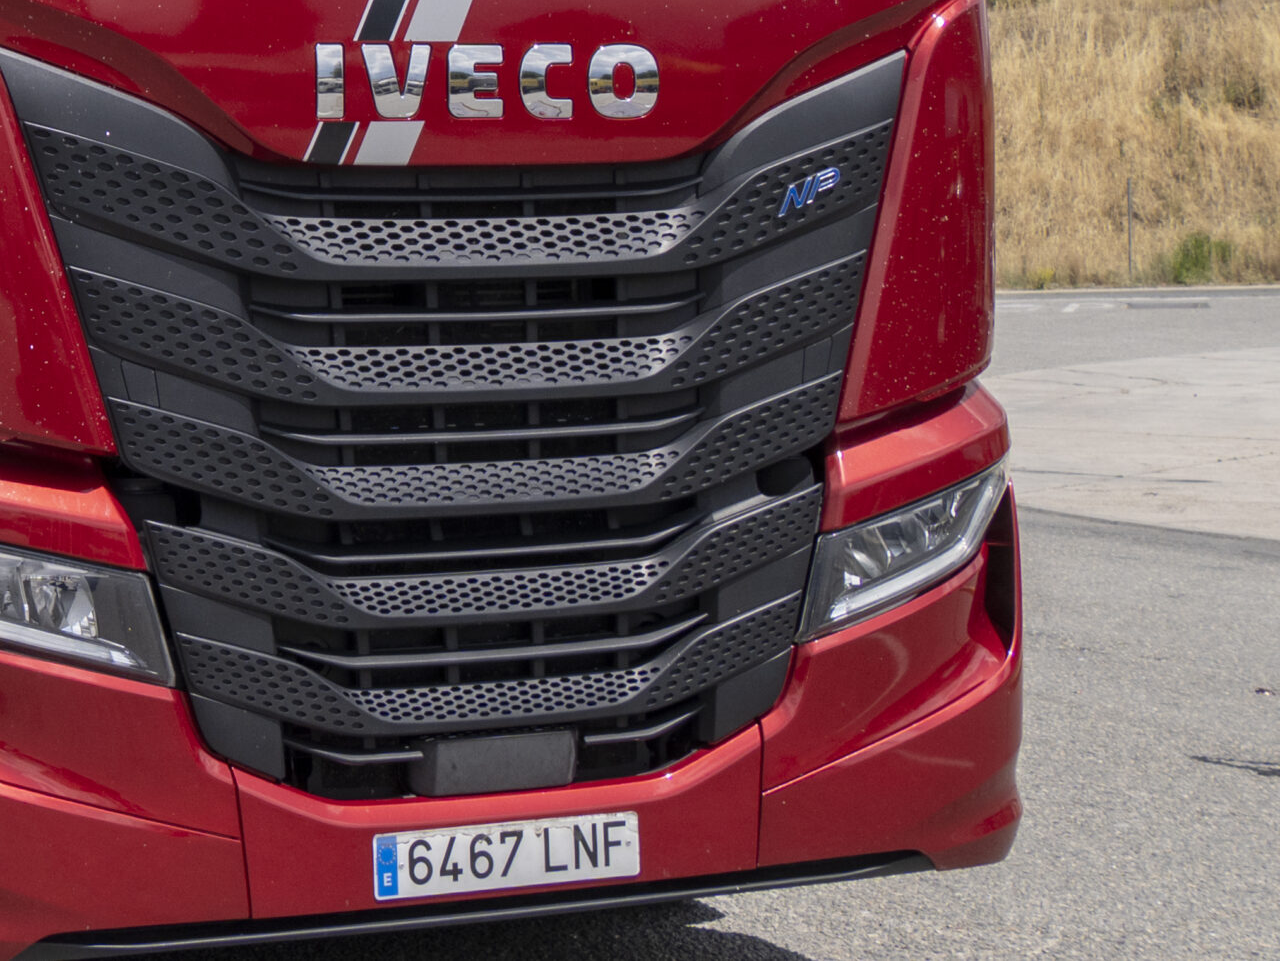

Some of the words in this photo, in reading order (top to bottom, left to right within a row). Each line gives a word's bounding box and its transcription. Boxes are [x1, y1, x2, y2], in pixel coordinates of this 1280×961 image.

[314, 42, 660, 120] IVECO
[778, 167, 841, 217] NP
[383, 872, 393, 887] E
[407, 829, 524, 886] 6467
[543, 820, 627, 874] LNF
